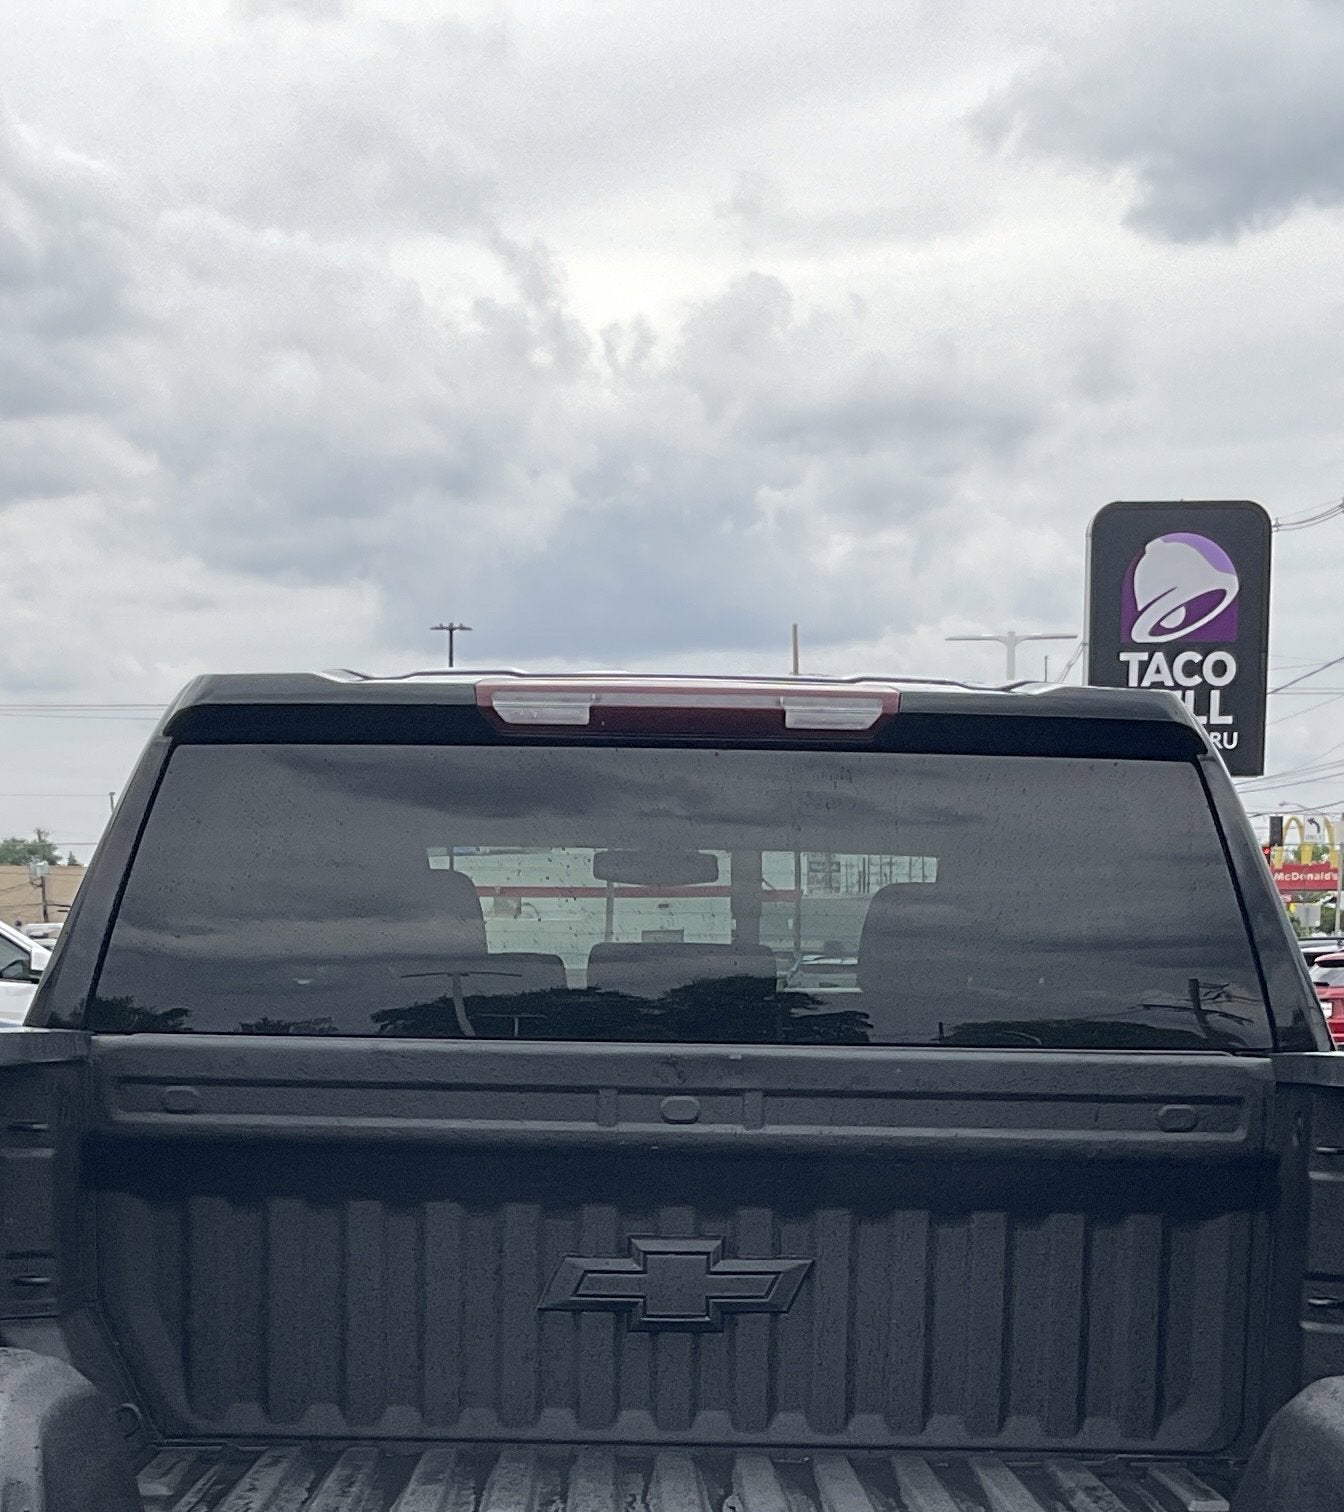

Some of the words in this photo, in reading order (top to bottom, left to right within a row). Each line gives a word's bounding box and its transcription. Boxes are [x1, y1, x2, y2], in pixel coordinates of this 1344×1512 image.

[1119, 650, 1237, 687] TACO
[1178, 689, 1233, 725] LL
[1273, 871, 1338, 881] McDonald's
